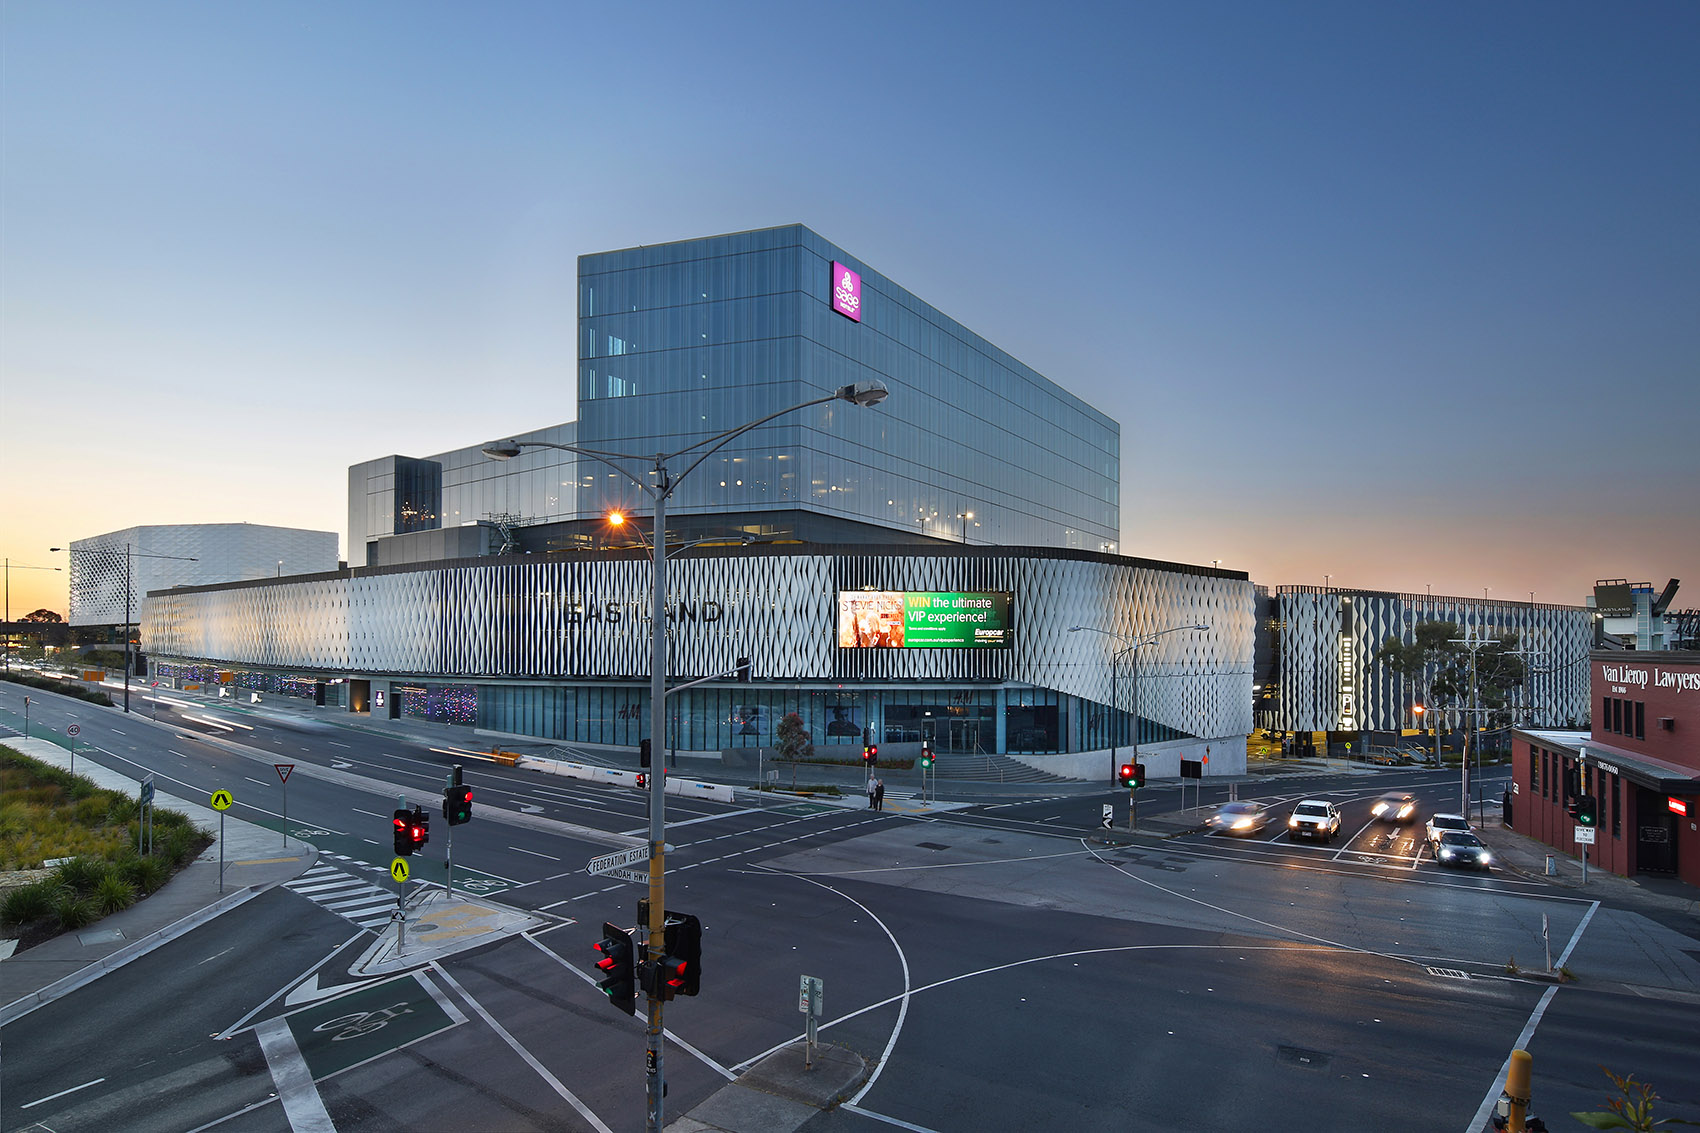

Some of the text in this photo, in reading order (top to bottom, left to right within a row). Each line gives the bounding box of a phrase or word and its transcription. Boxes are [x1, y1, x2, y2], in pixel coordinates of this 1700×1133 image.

[908, 597, 992, 608] WIN the ultimate
[568, 602, 722, 623] EASTLAND
[908, 611, 925, 622] VIP
[928, 611, 987, 624] experience!
[974, 628, 1004, 637] Europcar
[1602, 665, 1700, 693] Van Lierop Lawyers
[592, 847, 648, 872] FEDERATION ESTATE
[633, 872, 648, 882] HWY
